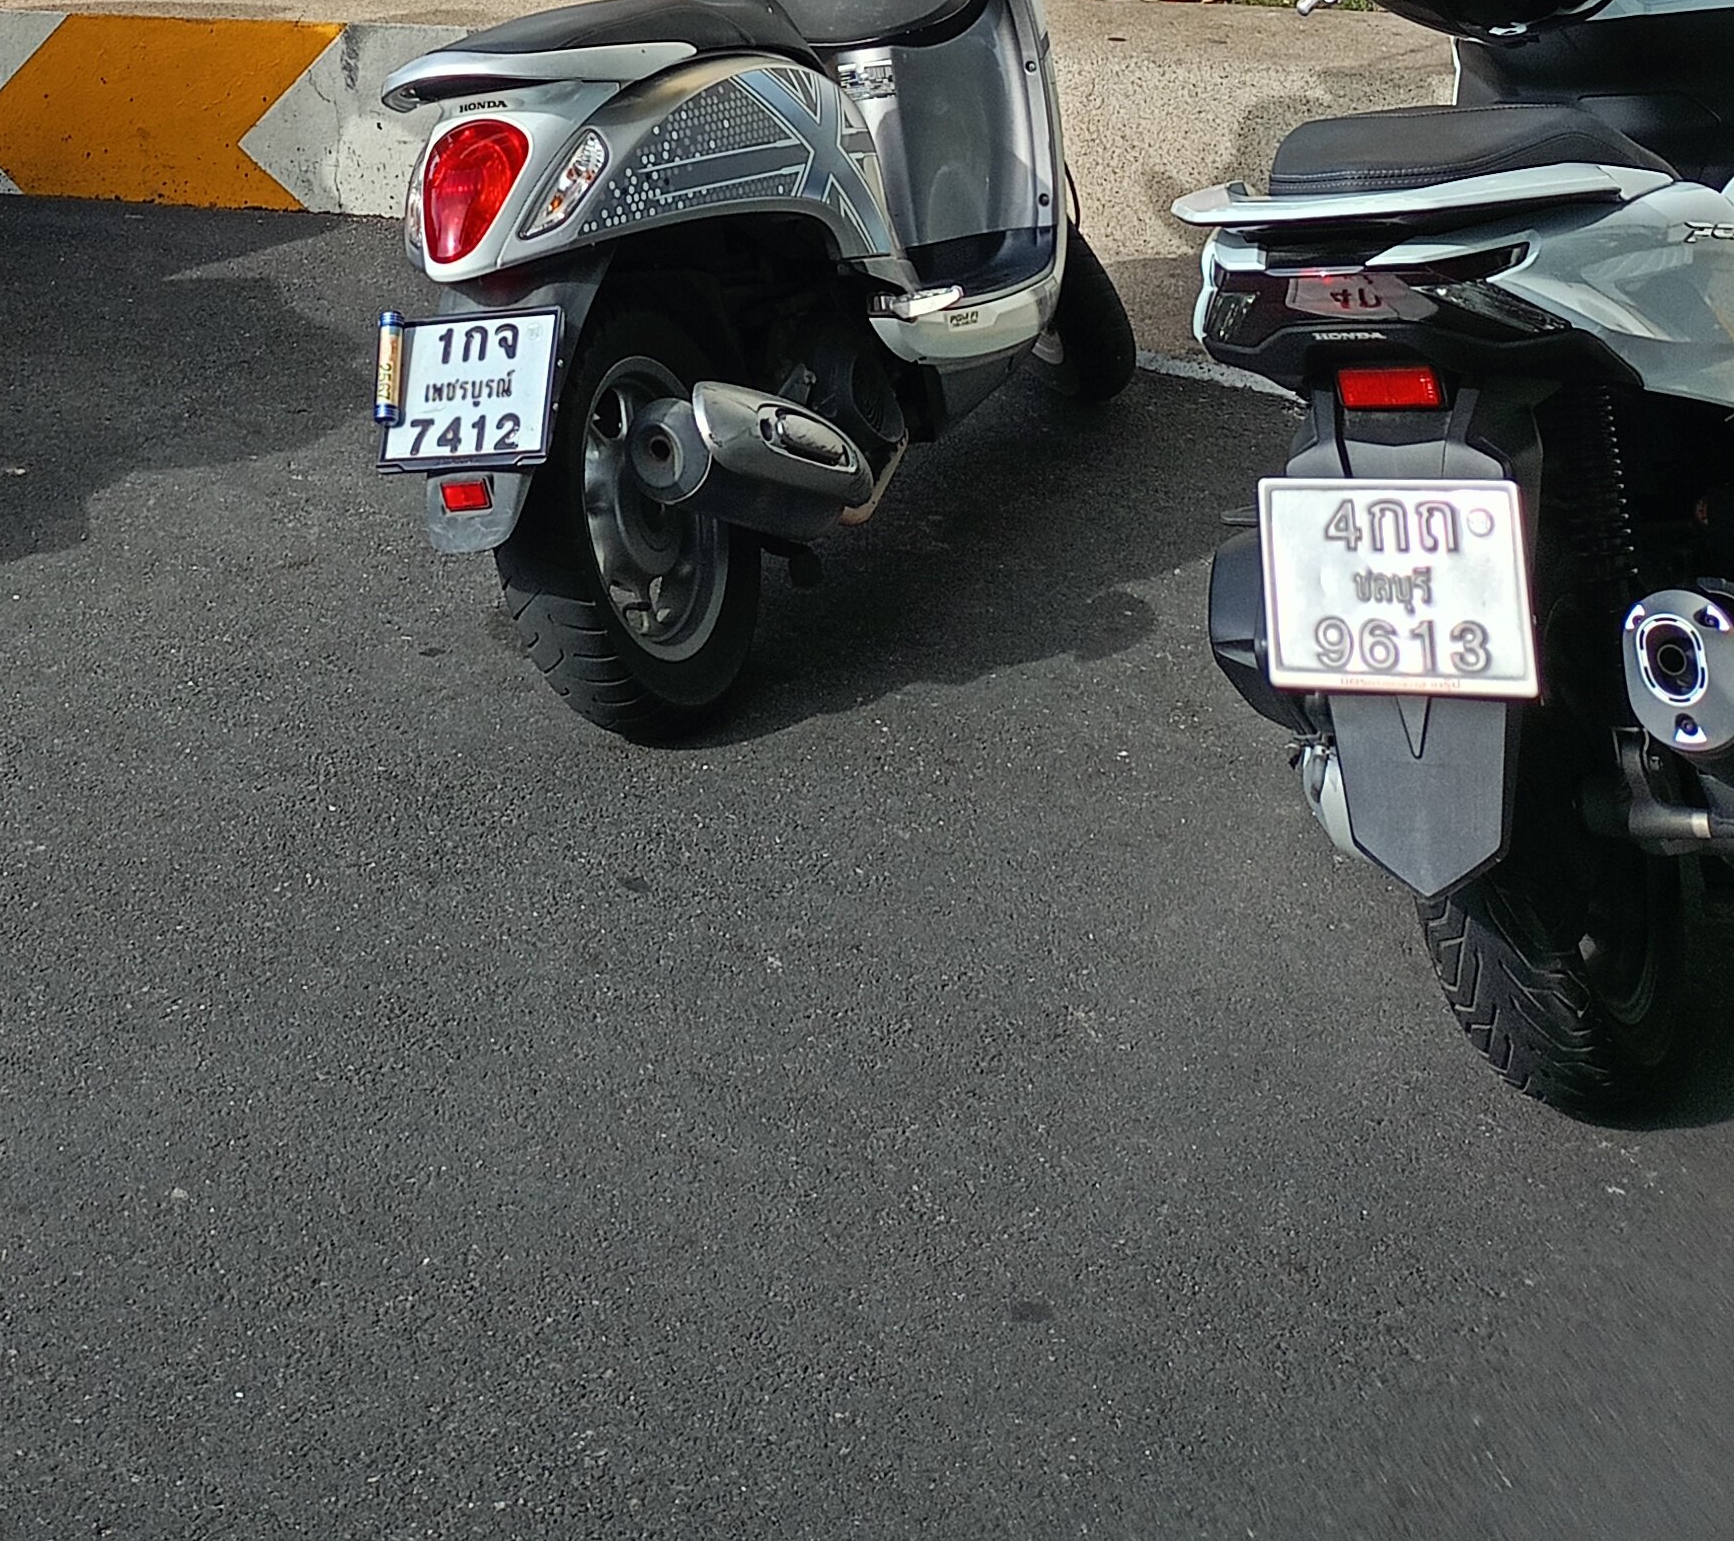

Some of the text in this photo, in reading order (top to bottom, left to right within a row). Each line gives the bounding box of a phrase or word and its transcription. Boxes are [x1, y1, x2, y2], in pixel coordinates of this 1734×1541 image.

[459, 100, 508, 113] HONDA
[1684, 220, 1734, 243] PC
[438, 323, 519, 365] 1กจ
[1312, 331, 1387, 341] HONDA
[424, 369, 516, 407] เพชรบูรณ์
[409, 412, 521, 456] 7412
[1324, 498, 1460, 553] 4กถ
[1353, 565, 1432, 615] ชลบุรี
[1315, 616, 1492, 674] 9613
